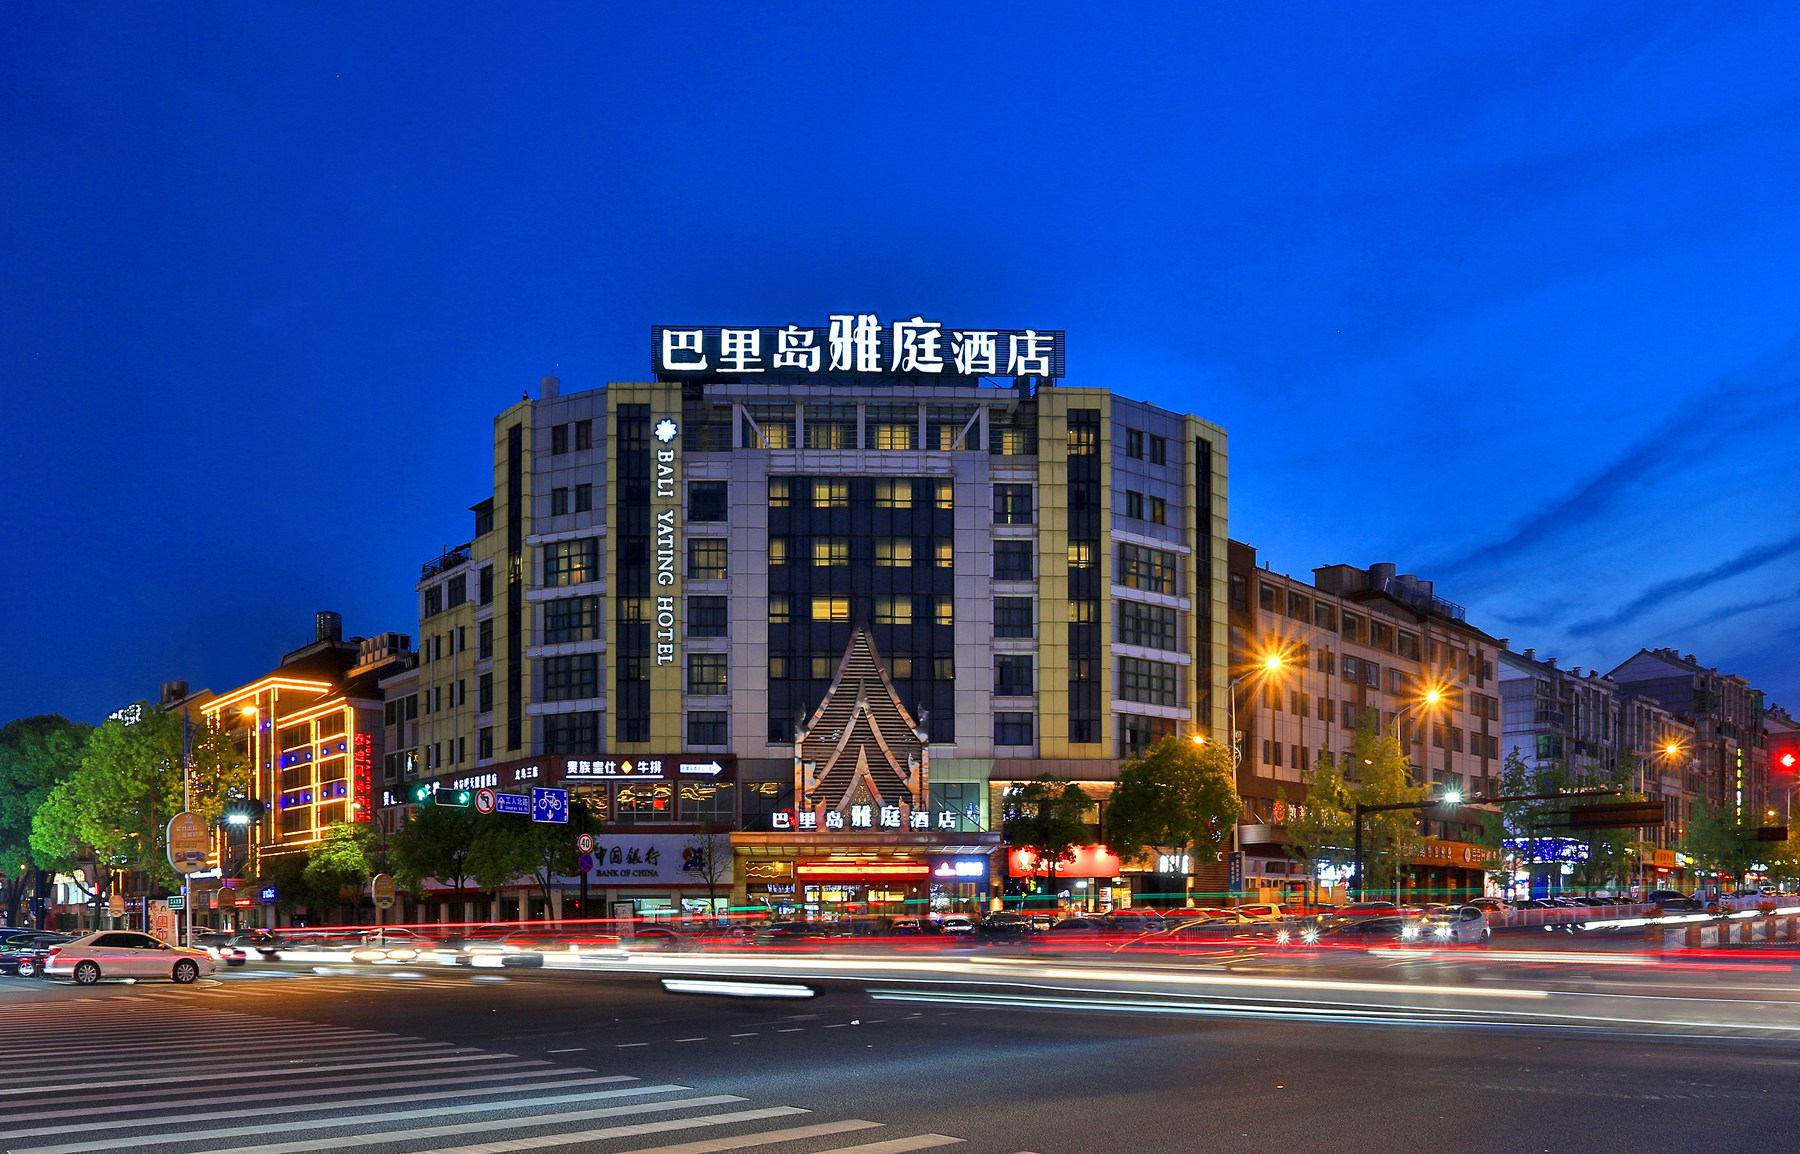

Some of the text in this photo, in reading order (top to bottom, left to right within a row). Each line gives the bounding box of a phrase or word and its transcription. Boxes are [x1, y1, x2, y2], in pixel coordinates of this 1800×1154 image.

[662, 314, 1055, 377] 巴里岛雅庭酒店
[657, 450, 674, 665] BALI YATING HOTEL
[567, 760, 662, 774] 贵族皇仕 牛排
[772, 805, 956, 829] 巴里岛雅庭酒店
[581, 838, 590, 848] 40
